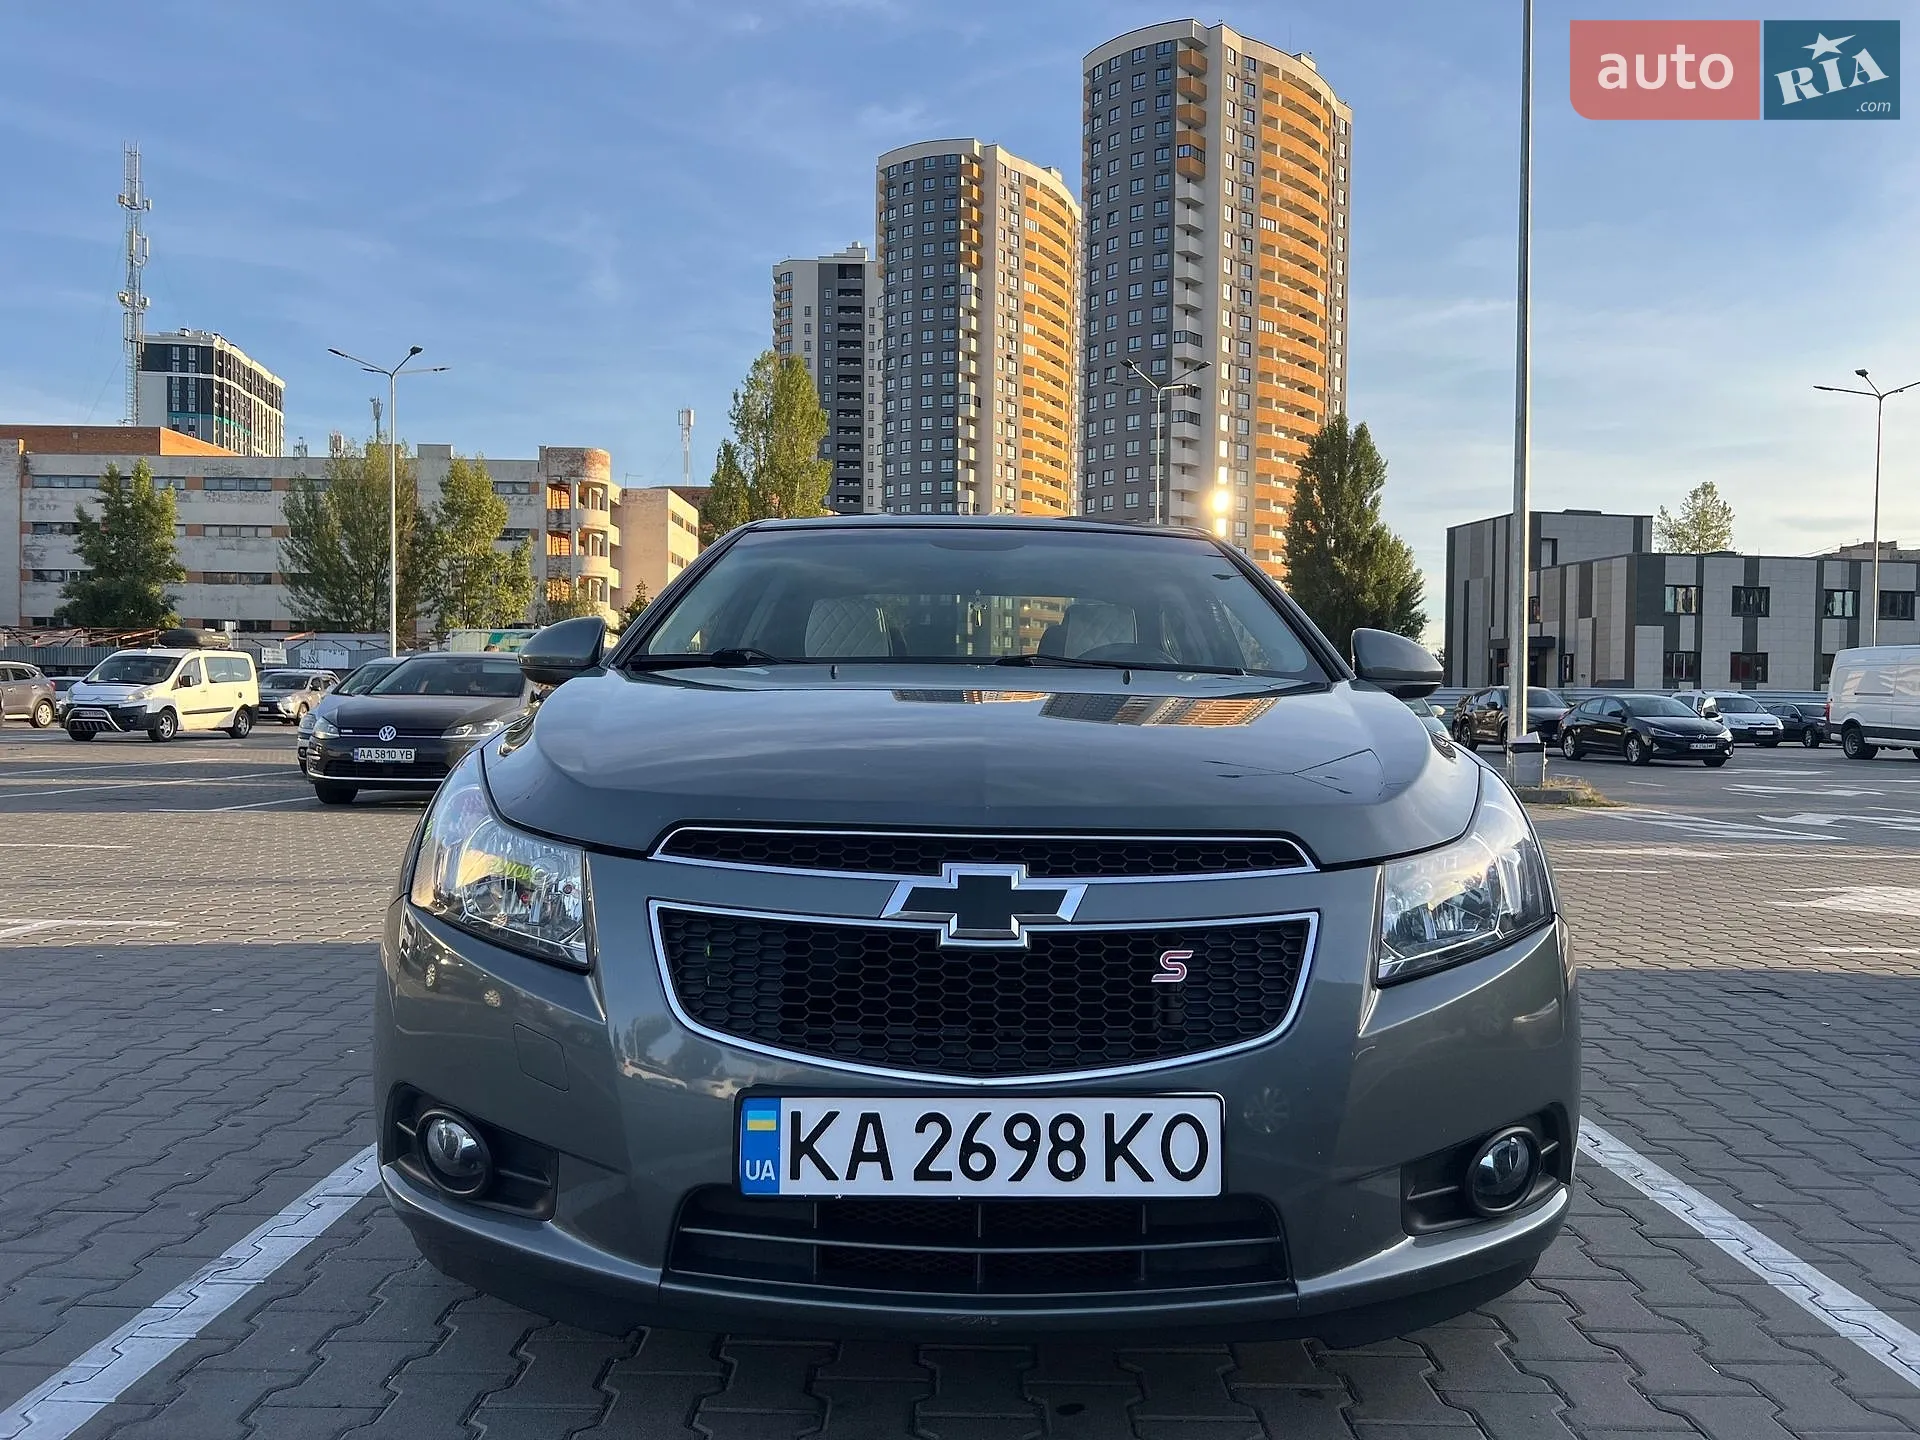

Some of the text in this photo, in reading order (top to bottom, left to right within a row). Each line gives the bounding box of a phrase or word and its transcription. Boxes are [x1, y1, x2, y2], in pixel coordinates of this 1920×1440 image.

[360, 749, 413, 760] AA 5810 YB
[1151, 950, 1194, 983] S
[788, 1110, 1209, 1183] KA 2698 KO
[745, 1159, 775, 1181] UA
